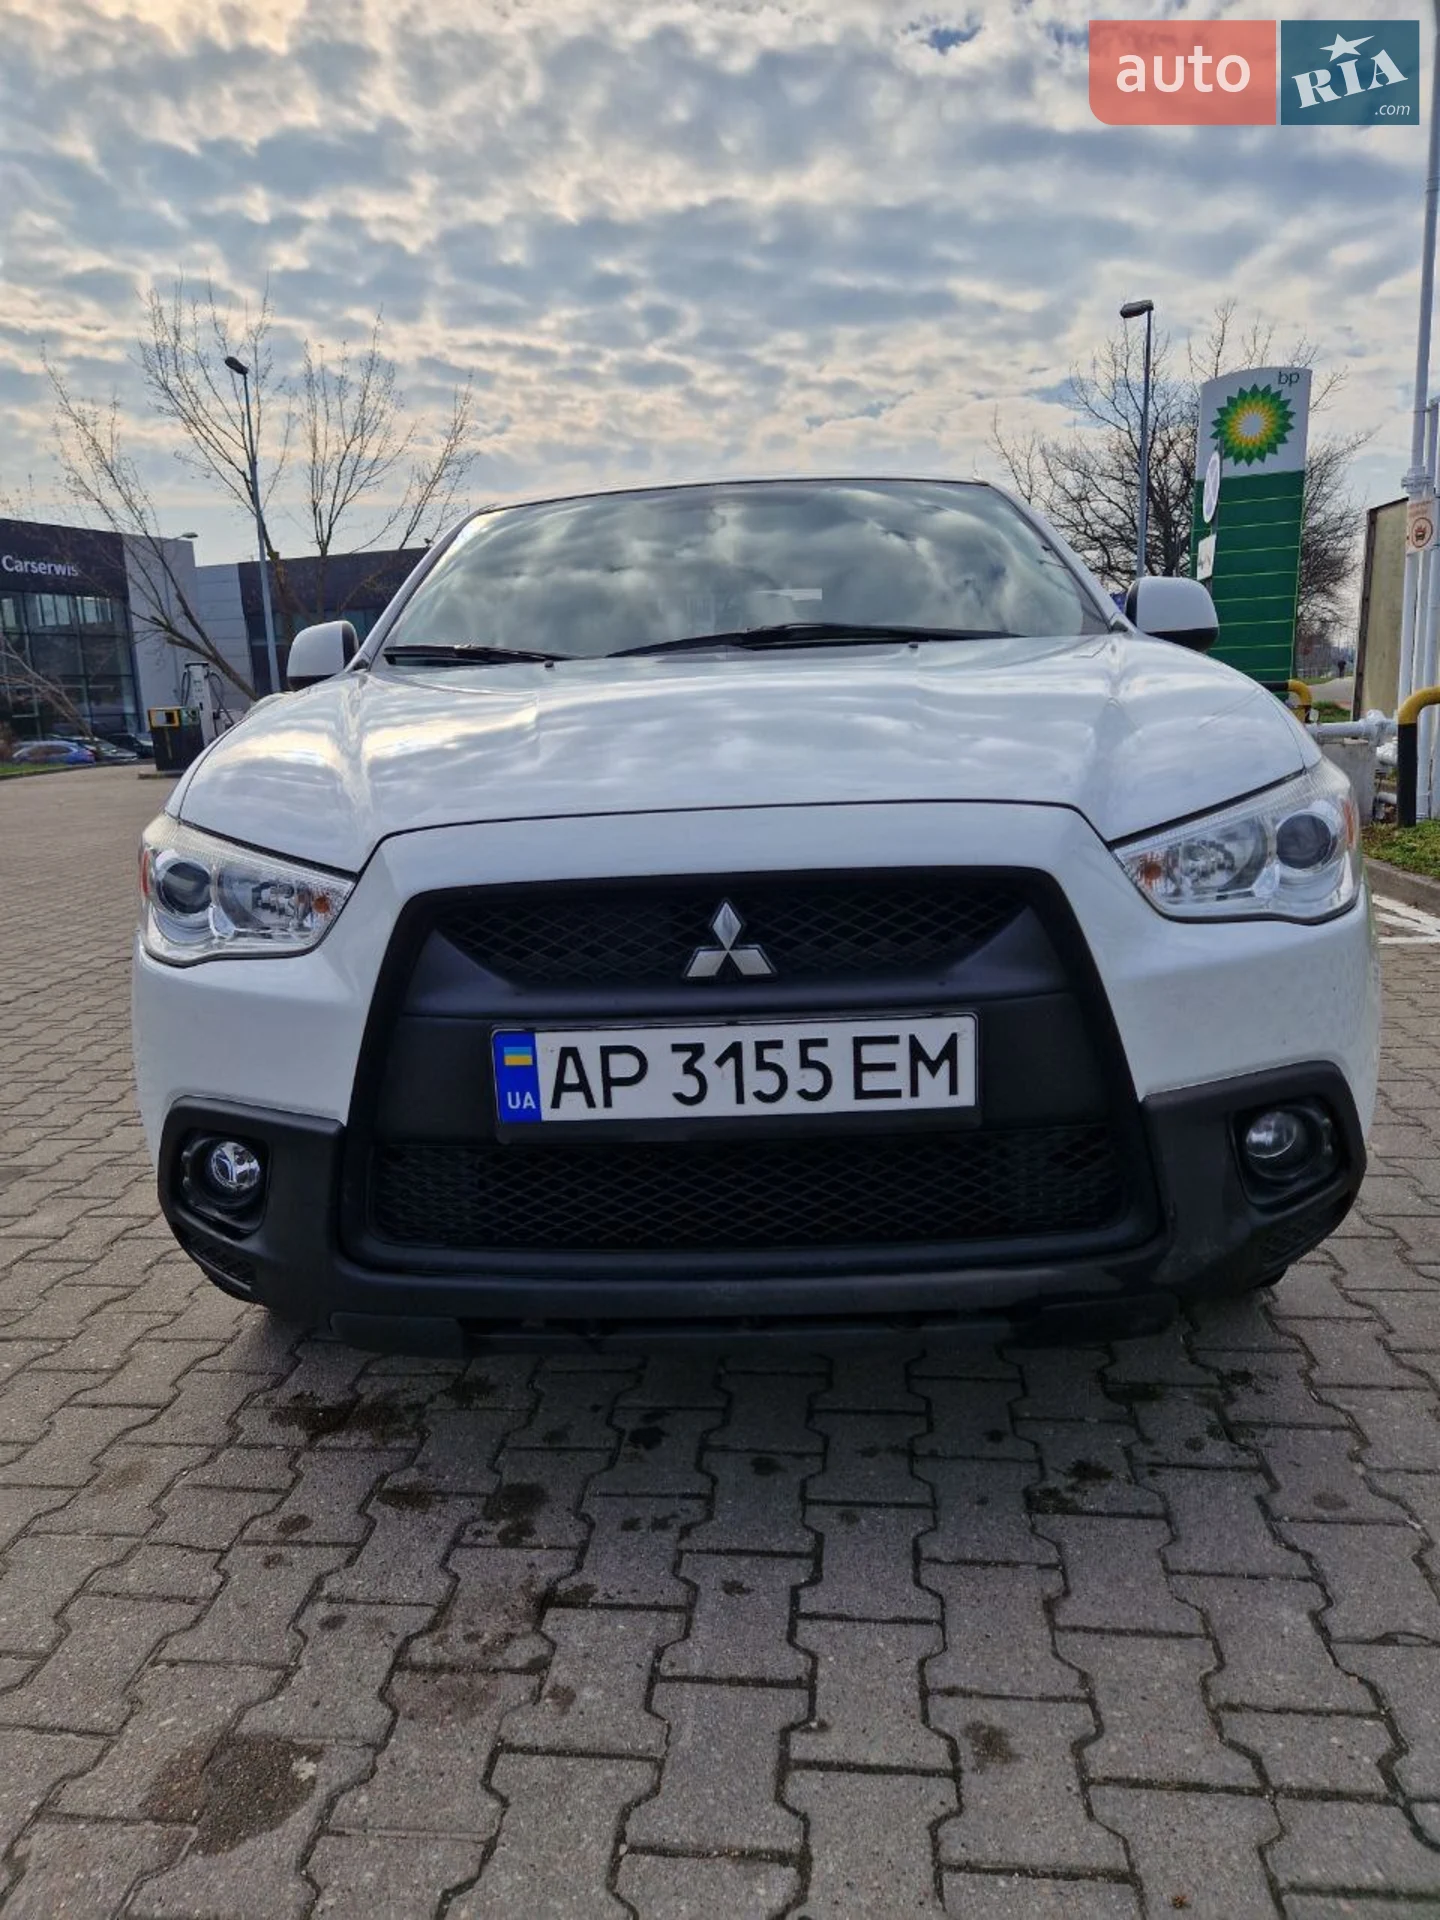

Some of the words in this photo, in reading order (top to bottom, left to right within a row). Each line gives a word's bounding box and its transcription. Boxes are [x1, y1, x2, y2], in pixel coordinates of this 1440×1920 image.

[1278, 371, 1300, 387] bp
[550, 1043, 649, 1110] AP
[671, 1037, 833, 1106] 3155
[852, 1032, 959, 1100] EM
[507, 1091, 537, 1110] UA
